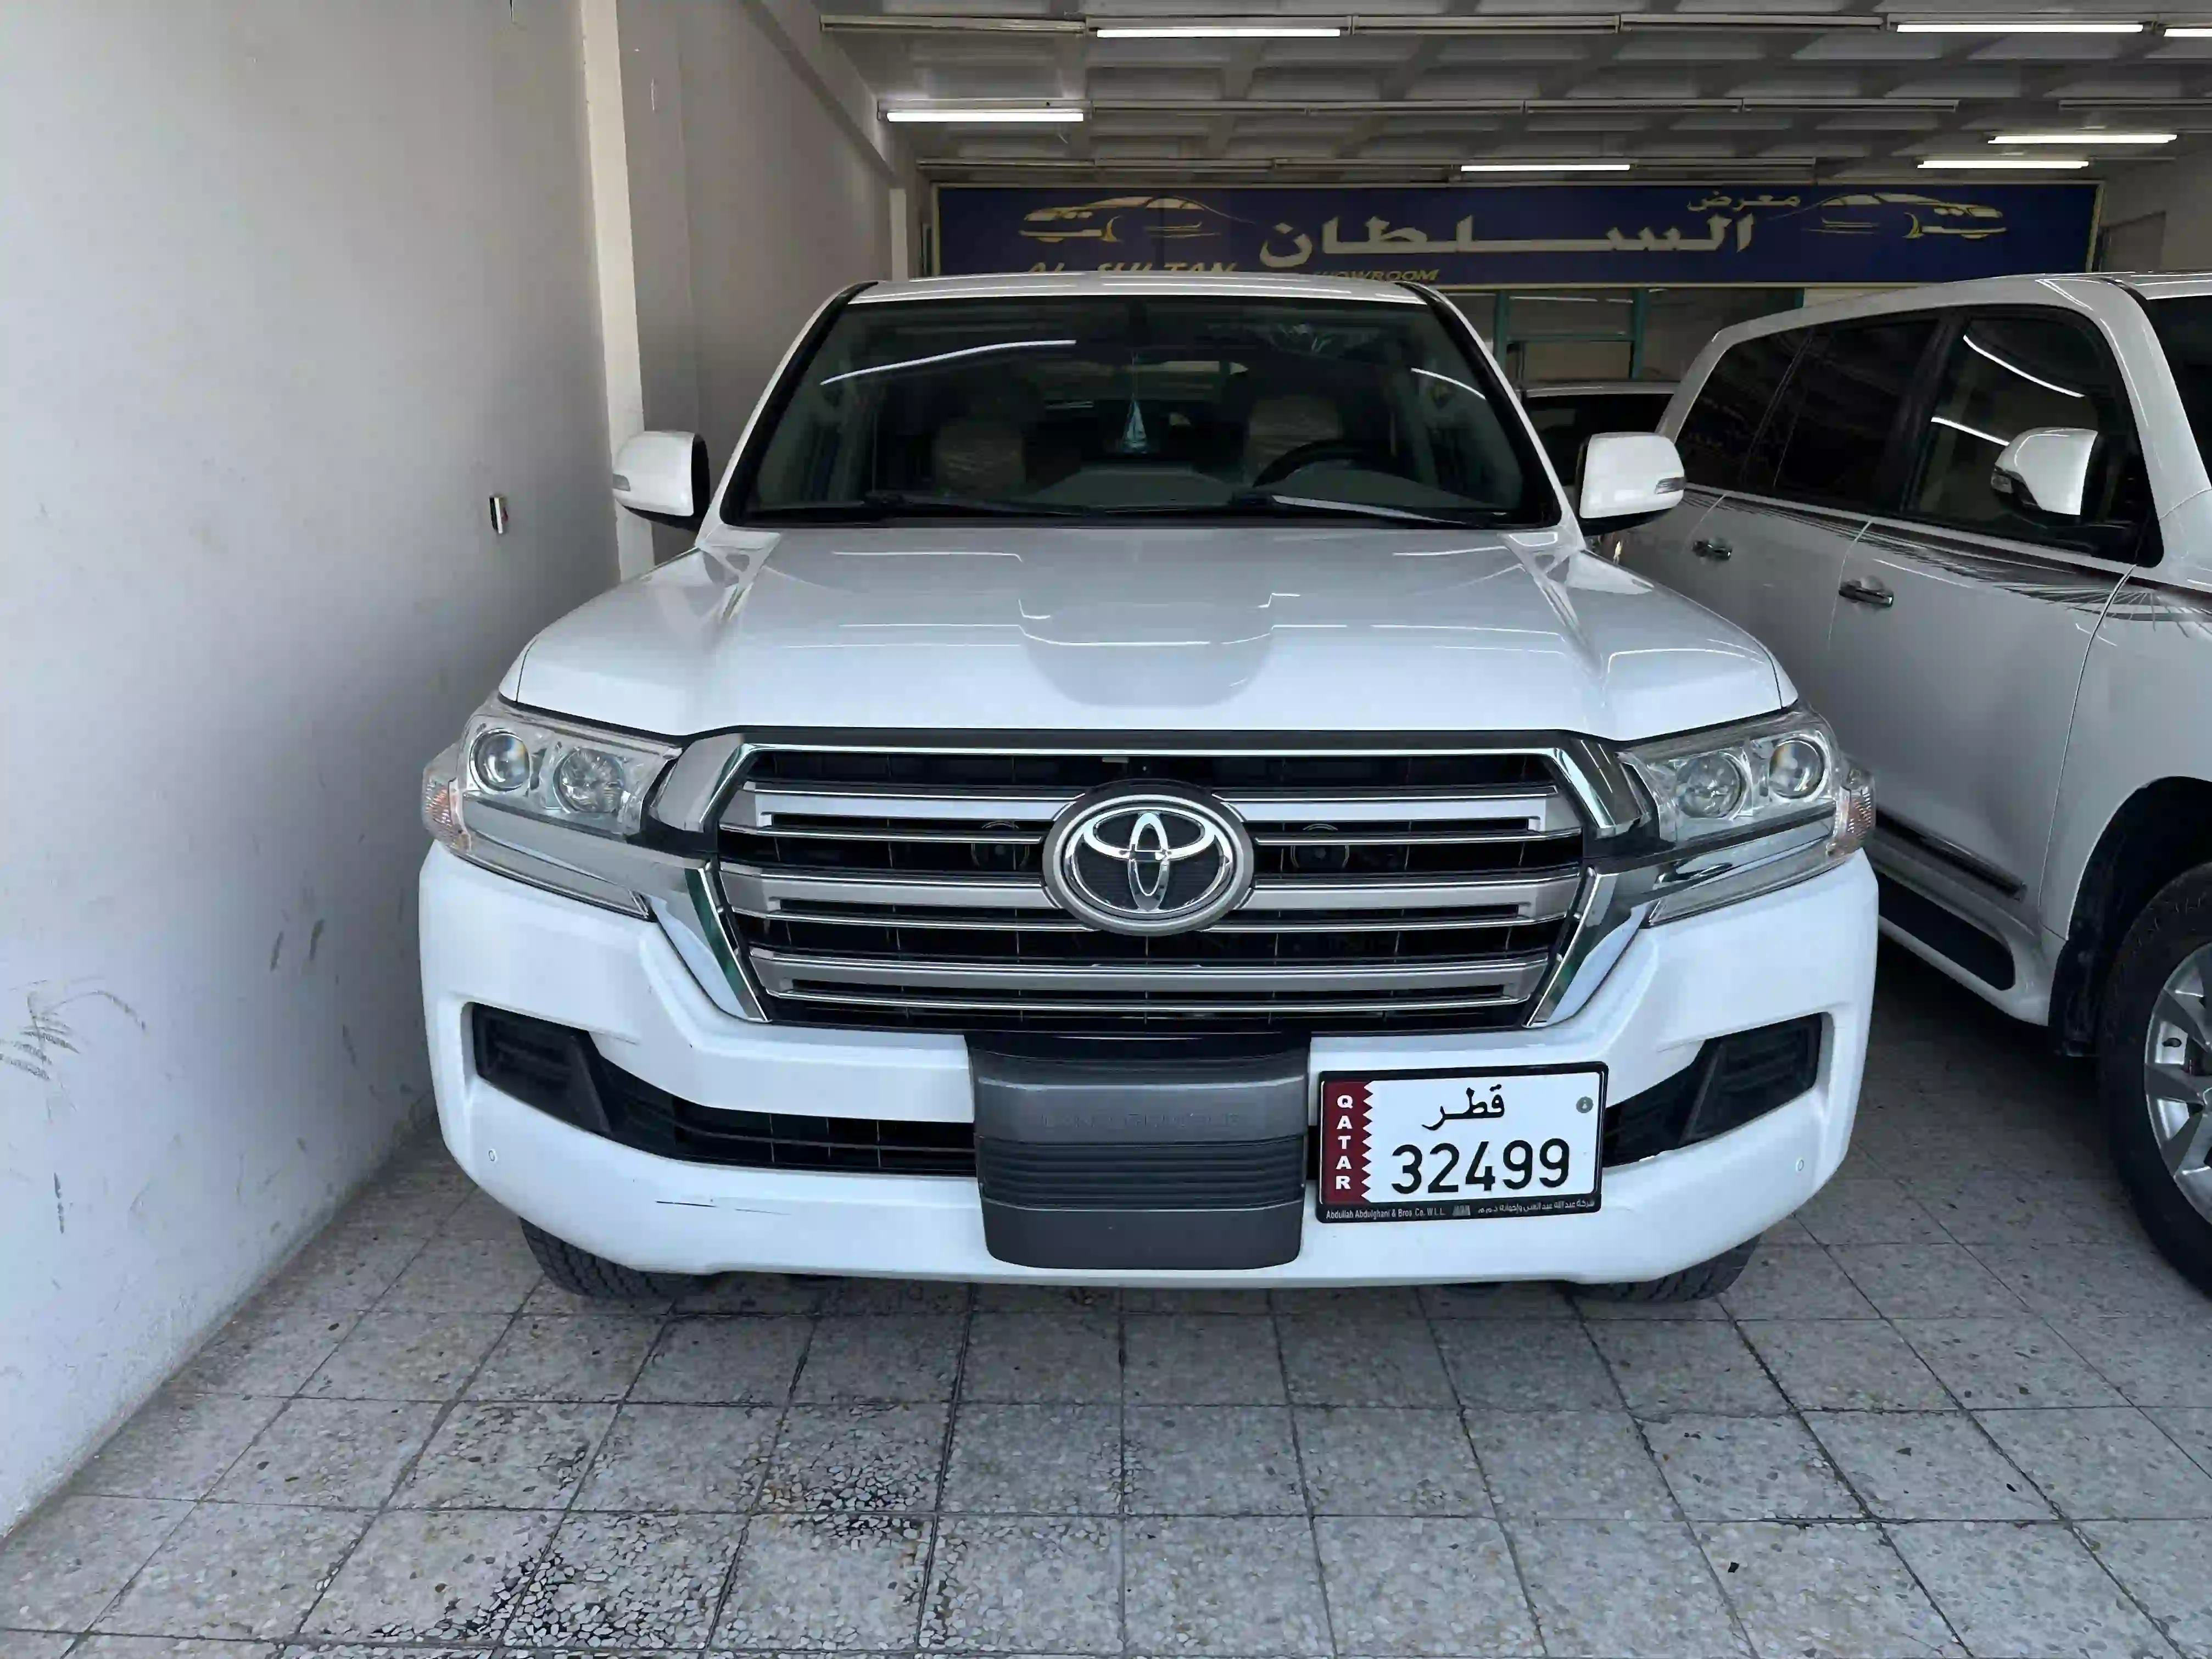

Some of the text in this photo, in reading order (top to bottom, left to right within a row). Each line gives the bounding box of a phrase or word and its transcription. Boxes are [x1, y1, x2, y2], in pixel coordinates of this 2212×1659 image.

[1686, 190, 1801, 212] معرض
[1259, 213, 1755, 268] السلطان
[1421, 1083, 1505, 1131] قطر
[1335, 1094, 1354, 1191] QATAR
[1390, 1137, 1571, 1194] 32499
[1326, 1210, 1354, 1219] Abdullah
[1355, 1209, 1390, 1220] Abdulghani
[1392, 1209, 1396, 1217] &
